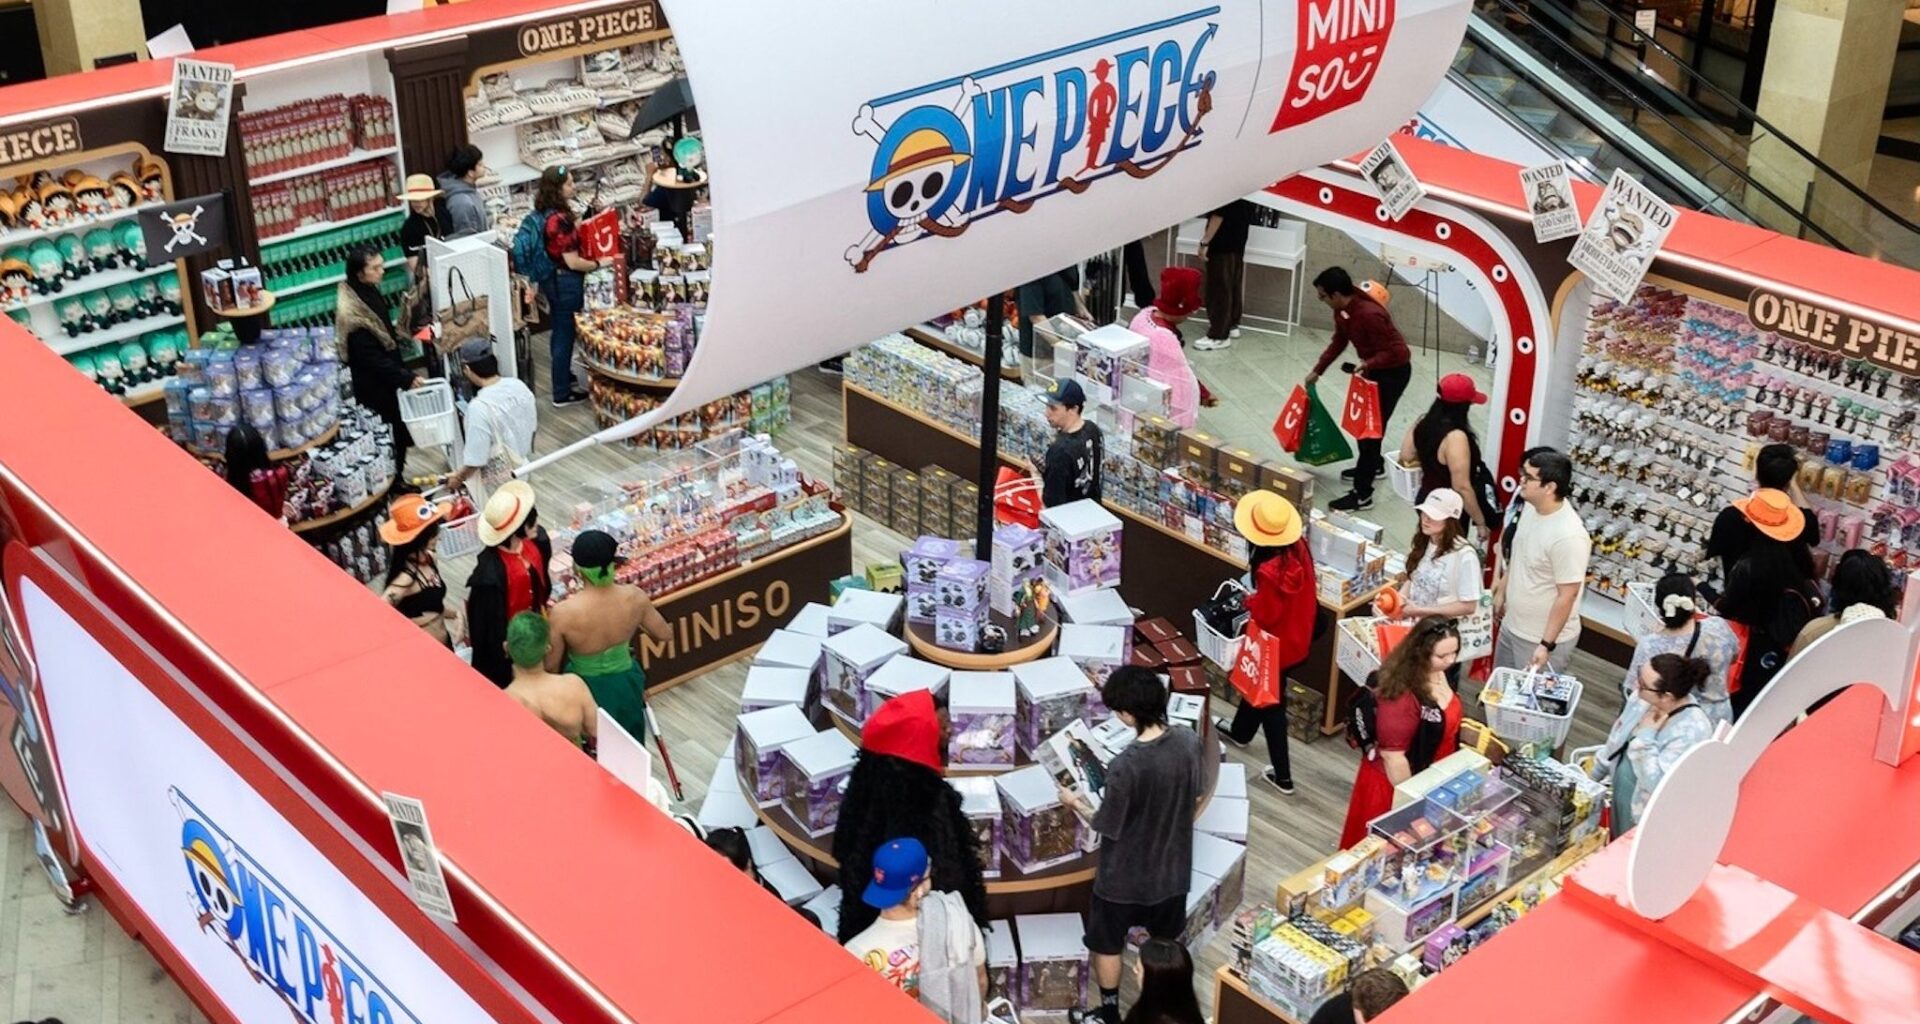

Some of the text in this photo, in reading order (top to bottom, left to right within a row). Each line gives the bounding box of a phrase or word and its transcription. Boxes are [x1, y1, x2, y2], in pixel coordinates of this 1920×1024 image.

[523, 6, 653, 52] ONE PIECE
[177, 63, 232, 82] WANTED
[174, 126, 218, 140] FRANKY
[866, 23, 1218, 240] ONE PIECE
[1360, 142, 1391, 174] WANTED
[1521, 164, 1563, 183] WANTED
[1613, 175, 1672, 229] WANTED
[1754, 293, 1841, 345] ONE
[640, 580, 791, 670] MINISO
[182, 818, 300, 1004] ONE
